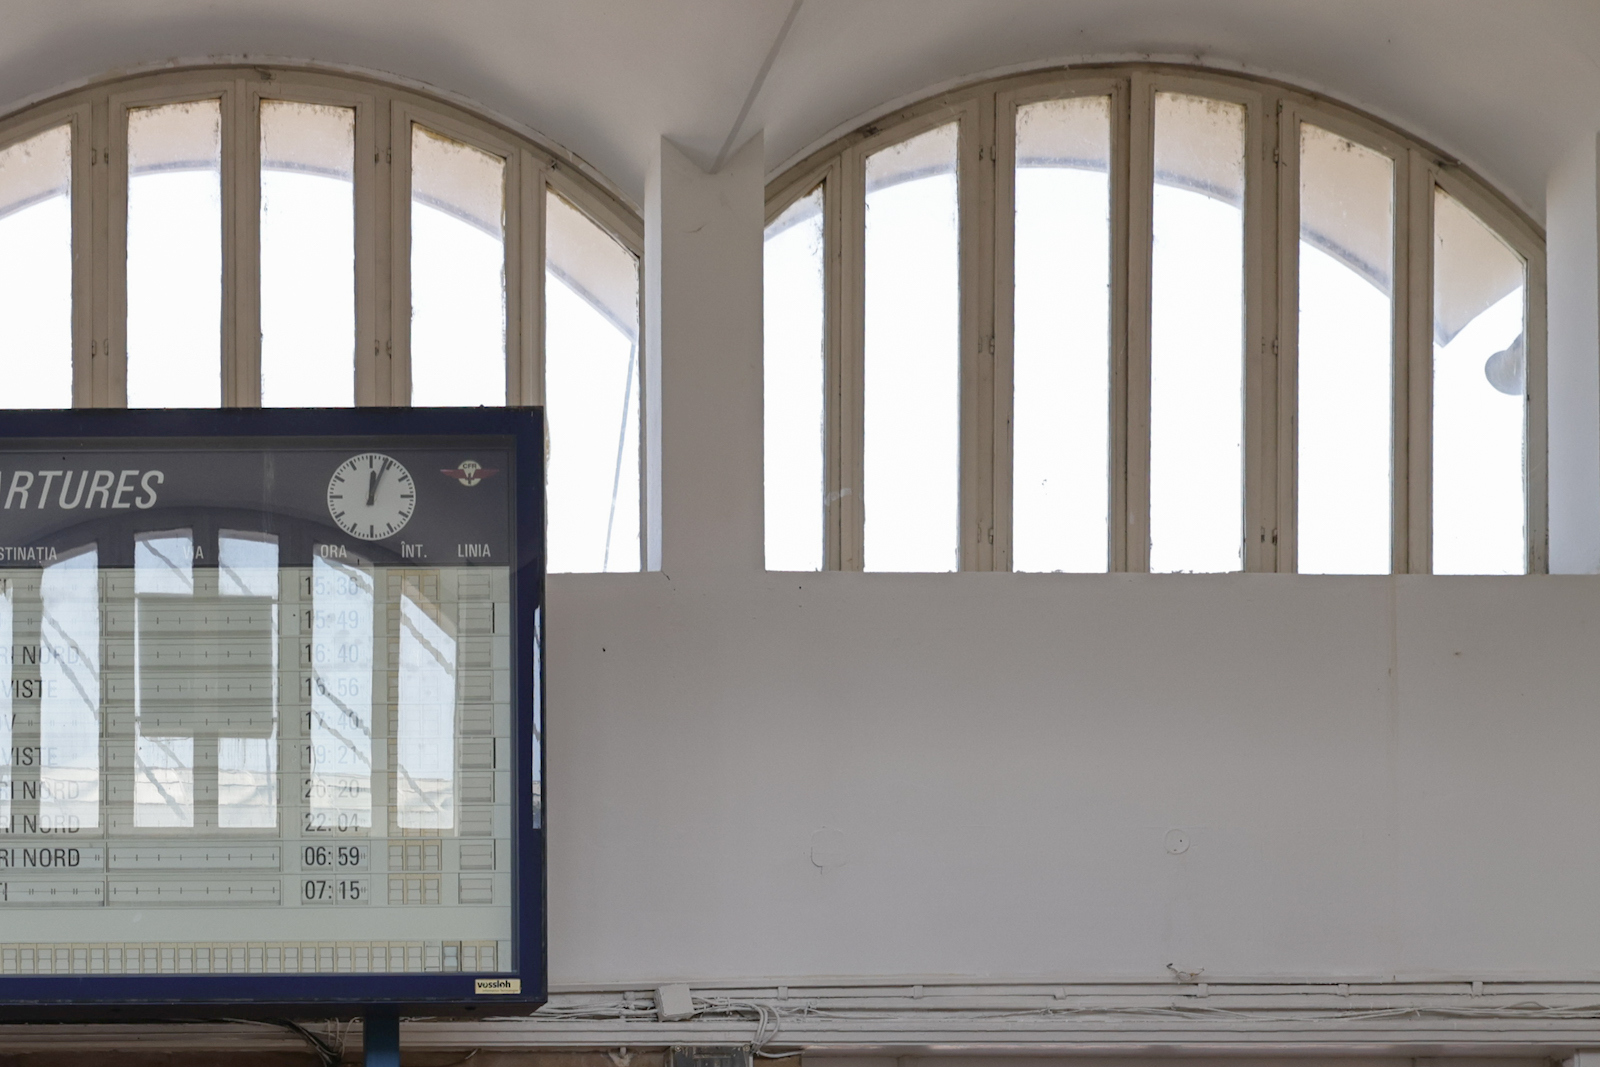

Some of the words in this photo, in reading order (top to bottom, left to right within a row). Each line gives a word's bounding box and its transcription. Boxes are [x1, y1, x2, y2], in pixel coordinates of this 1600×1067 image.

[320, 544, 347, 558] ORA
[401, 541, 427, 558] ÎNT.
[458, 544, 491, 558] LINIA
[22, 849, 80, 868] NORD
[304, 847, 360, 866] 06:59
[304, 880, 360, 899] 07:15
